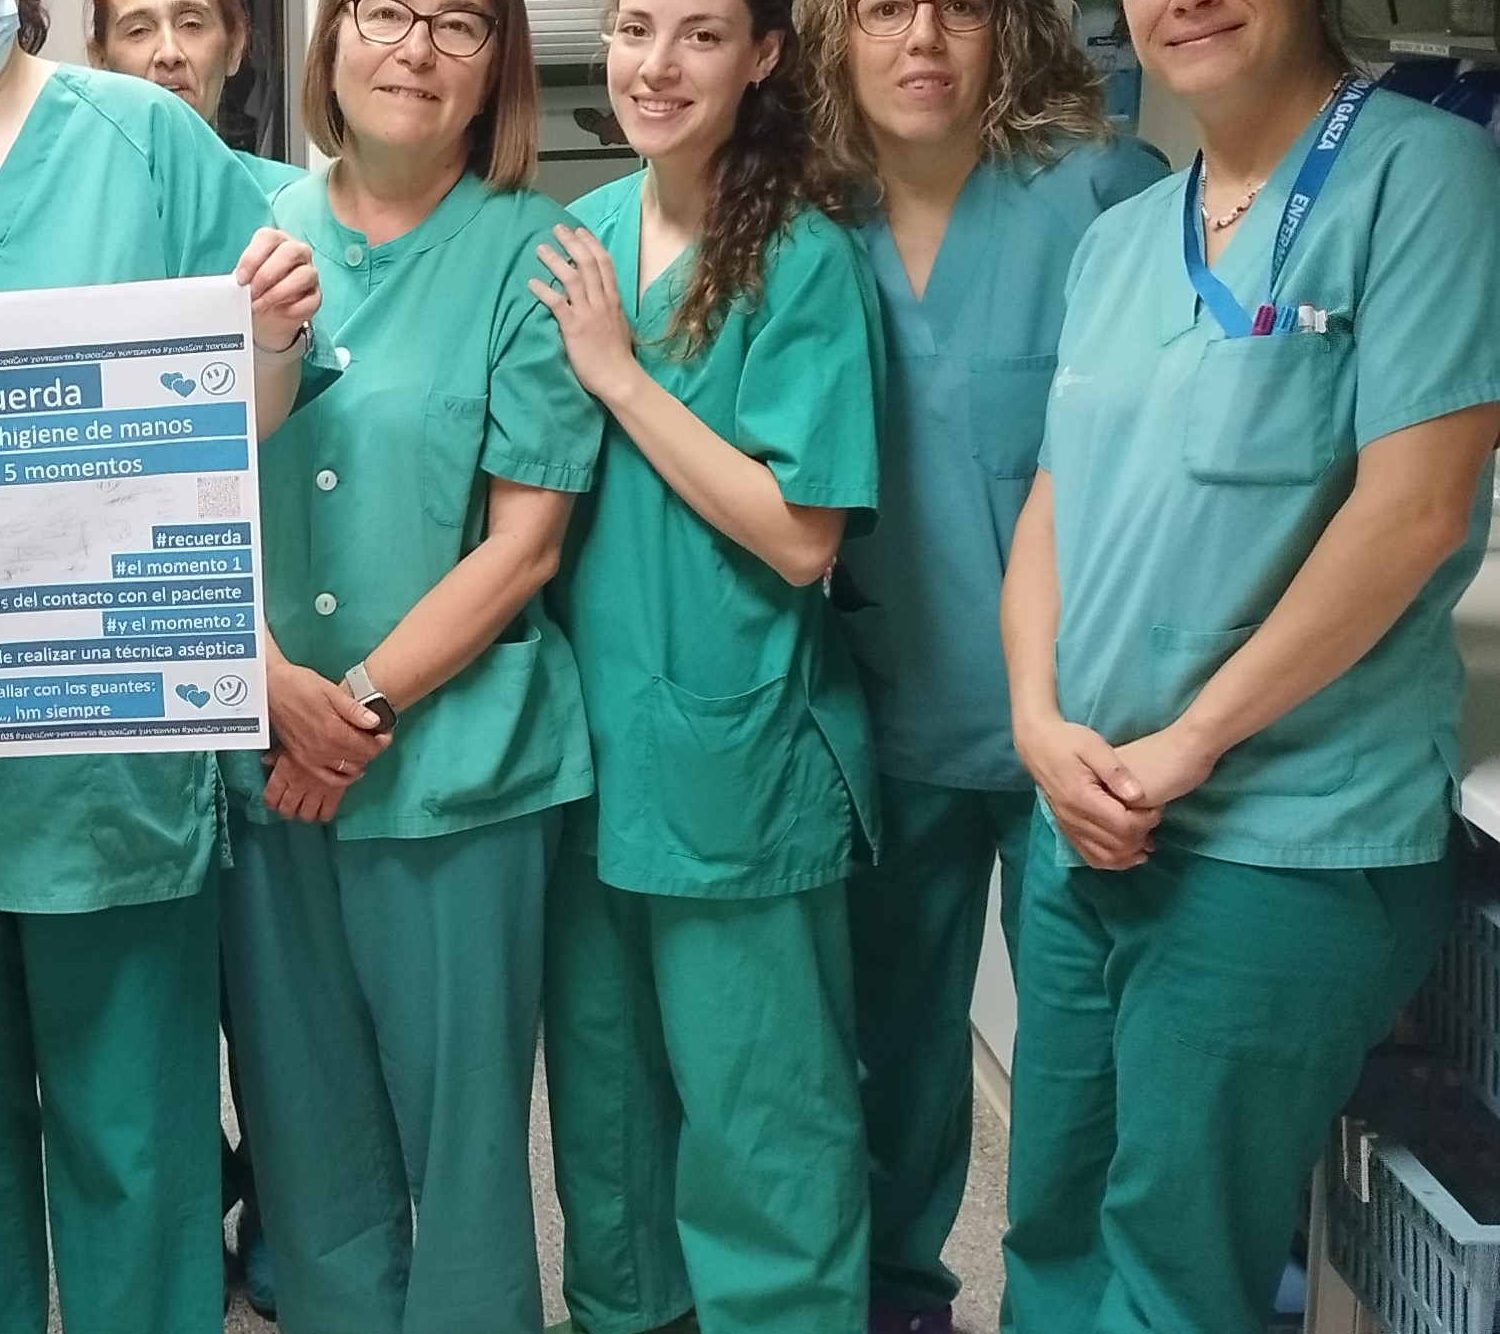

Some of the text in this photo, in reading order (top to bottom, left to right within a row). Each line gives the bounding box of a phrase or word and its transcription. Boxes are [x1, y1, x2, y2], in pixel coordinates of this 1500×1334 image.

[1317, 101, 1355, 152] GASZA
[0, 424, 79, 449] higiene
[85, 420, 113, 441] de
[120, 417, 193, 438] manos
[4, 462, 17, 482] 5
[25, 457, 143, 480] momentos
[156, 529, 242, 548] #recuerda
[115, 556, 243, 576] #el momento 1
[13, 591, 38, 608] del
[42, 591, 114, 607] contacto
[117, 591, 147, 604] con
[152, 587, 166, 603] el
[171, 584, 242, 605] paciente
[106, 613, 246, 635] #y el momento 2
[17, 646, 77, 663] realizar
[81, 647, 112, 661] una
[115, 640, 173, 659] técnica
[178, 639, 245, 659] aséptica
[33, 685, 61, 698] con
[65, 681, 87, 696] los
[15, 705, 41, 722] hm
[45, 702, 112, 721] siempre
